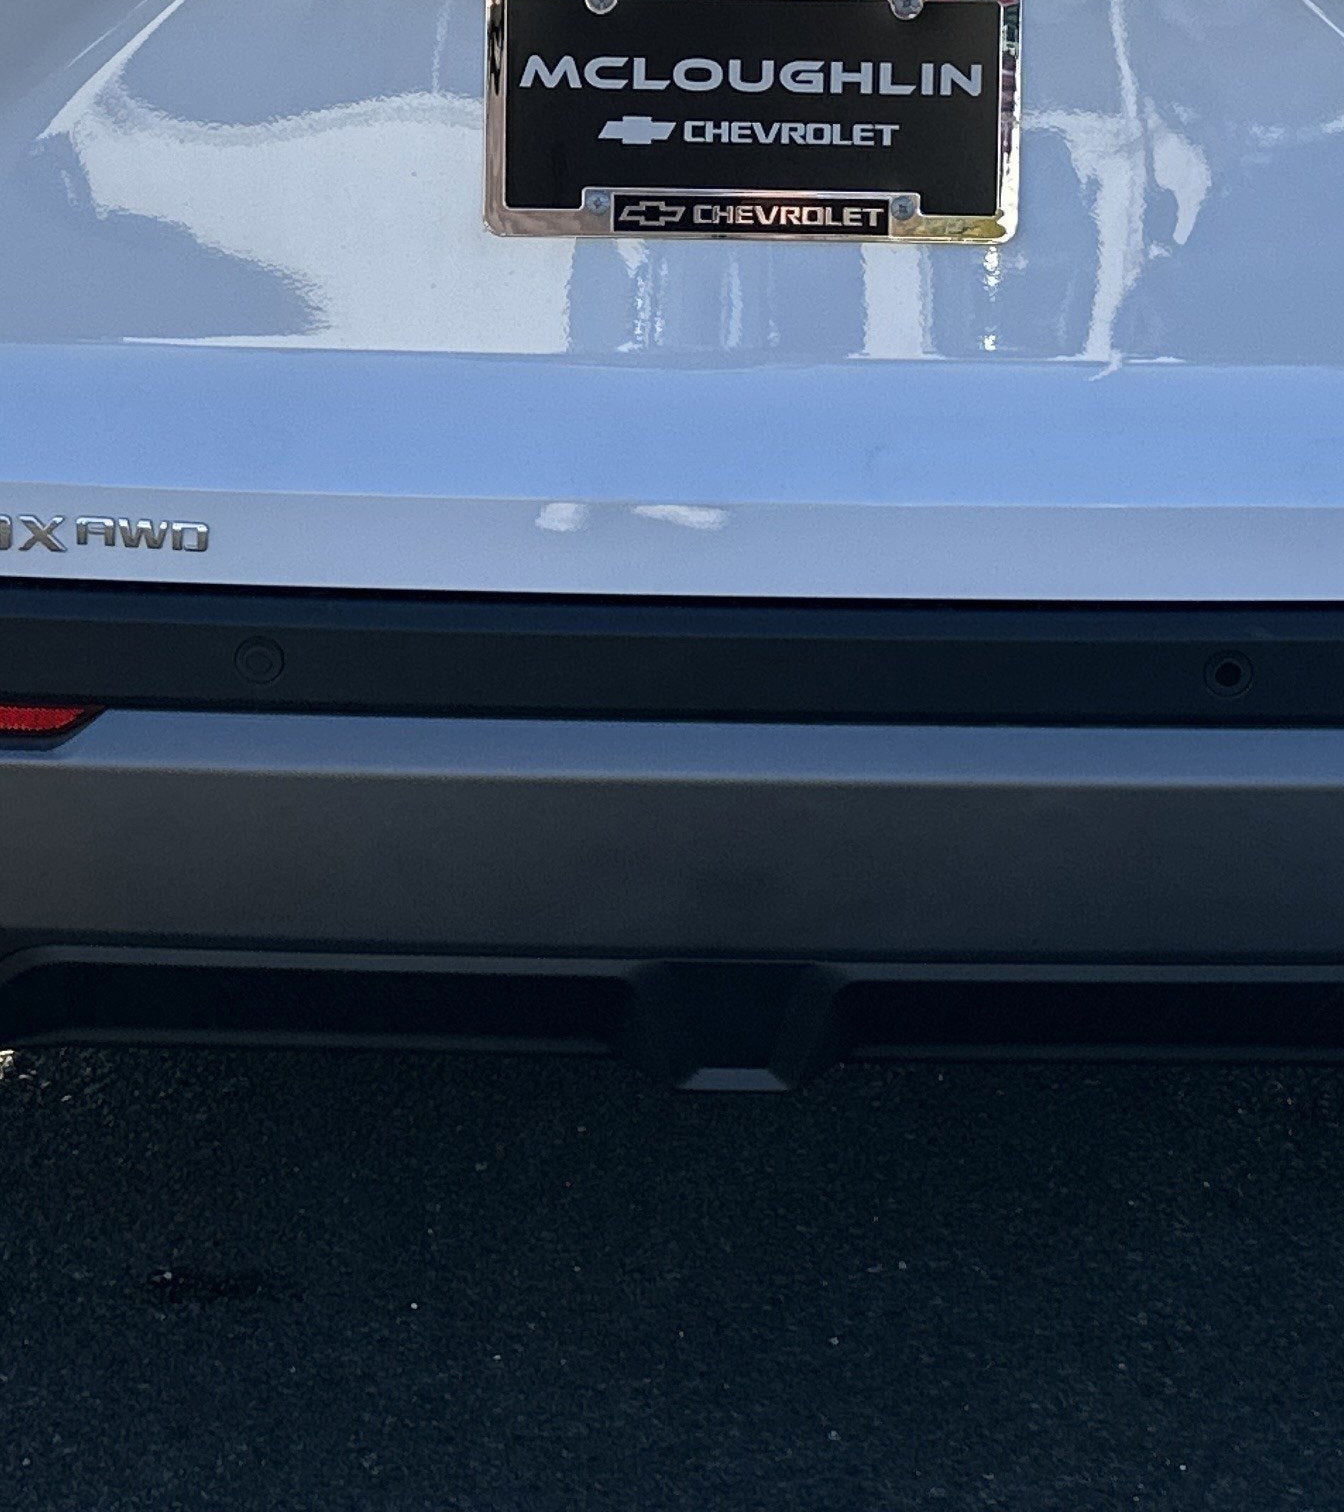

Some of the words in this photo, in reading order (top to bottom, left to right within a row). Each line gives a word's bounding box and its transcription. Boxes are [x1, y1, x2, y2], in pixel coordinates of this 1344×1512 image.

[519, 54, 983, 97] MCLOUGHLIN
[683, 120, 900, 146] CHEVROLET
[693, 204, 885, 227] CHEVROLET
[75, 516, 210, 553] AWD
